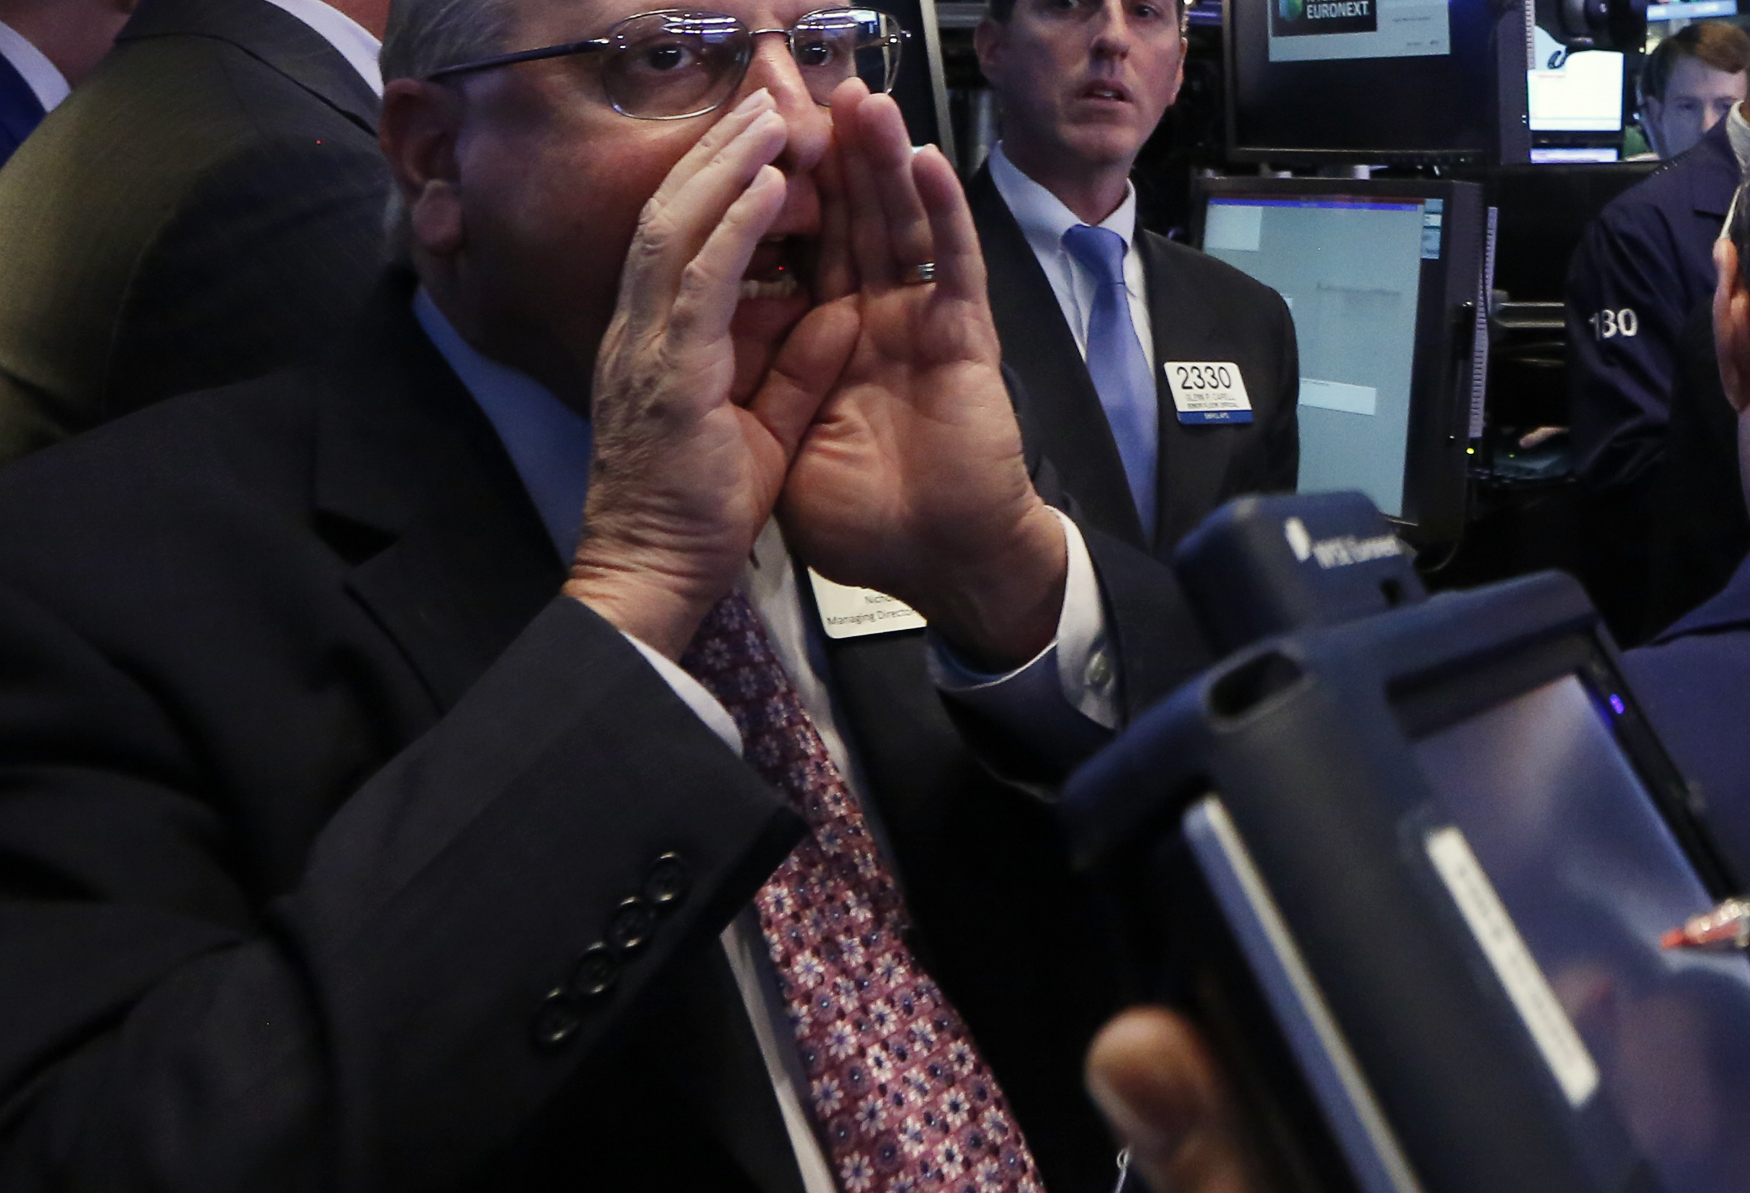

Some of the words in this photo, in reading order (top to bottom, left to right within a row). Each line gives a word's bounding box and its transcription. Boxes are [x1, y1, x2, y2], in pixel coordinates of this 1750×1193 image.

[1306, 0, 1369, 20] EURONEXT
[1177, 366, 1231, 389] 2330
[827, 611, 875, 626] Managing
